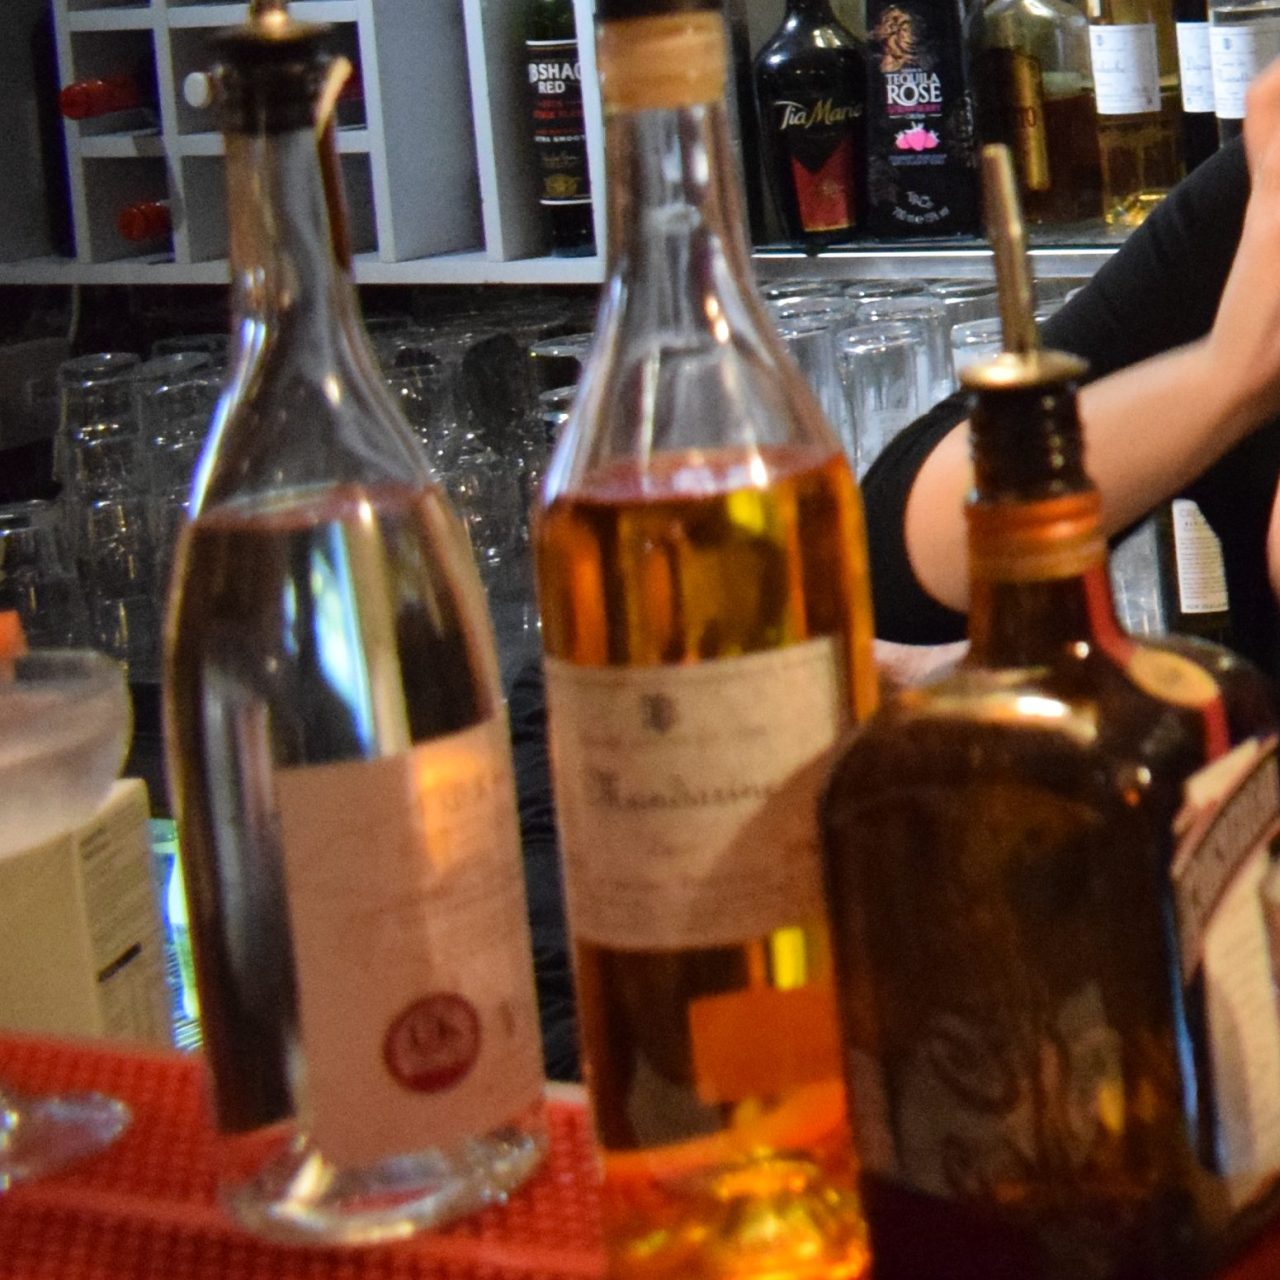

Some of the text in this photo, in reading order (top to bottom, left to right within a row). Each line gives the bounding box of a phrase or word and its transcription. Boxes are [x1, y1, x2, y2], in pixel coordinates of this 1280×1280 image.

[538, 81, 565, 94] RED
[885, 72, 941, 86] TEQUILA
[886, 83, 943, 107] ROSE
[774, 100, 808, 130] Tia
